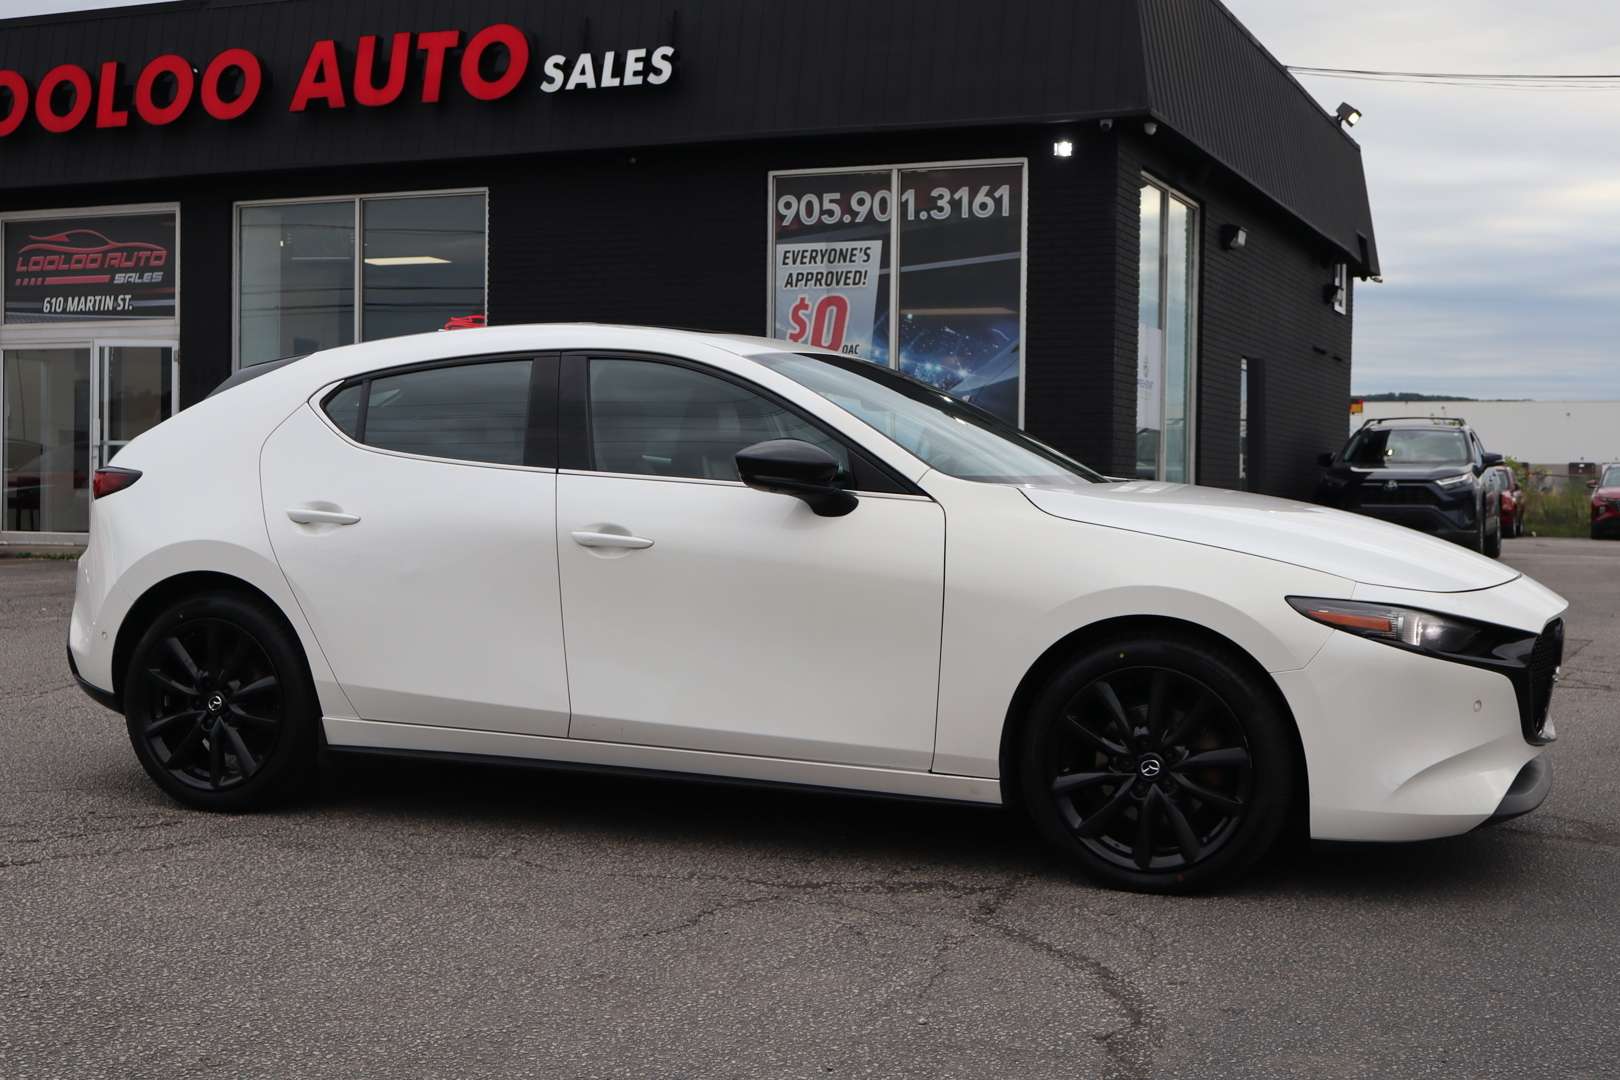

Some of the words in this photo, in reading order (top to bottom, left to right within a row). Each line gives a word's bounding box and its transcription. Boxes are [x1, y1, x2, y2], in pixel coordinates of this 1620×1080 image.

[289, 23, 531, 112] AUTO
[540, 45, 675, 94] SALES
[777, 184, 1010, 226] 905.901.3161
[16, 254, 102, 272] LOOLOO
[105, 251, 167, 268] AUTO
[781, 246, 872, 266] EVERYONE'S
[113, 272, 163, 283] SALES
[783, 270, 868, 288] APPROVED!
[43, 297, 64, 313] 610
[66, 295, 113, 312] MARTIN
[116, 294, 133, 311] ST.
[788, 295, 849, 352] $0
[842, 343, 860, 354] OAC
